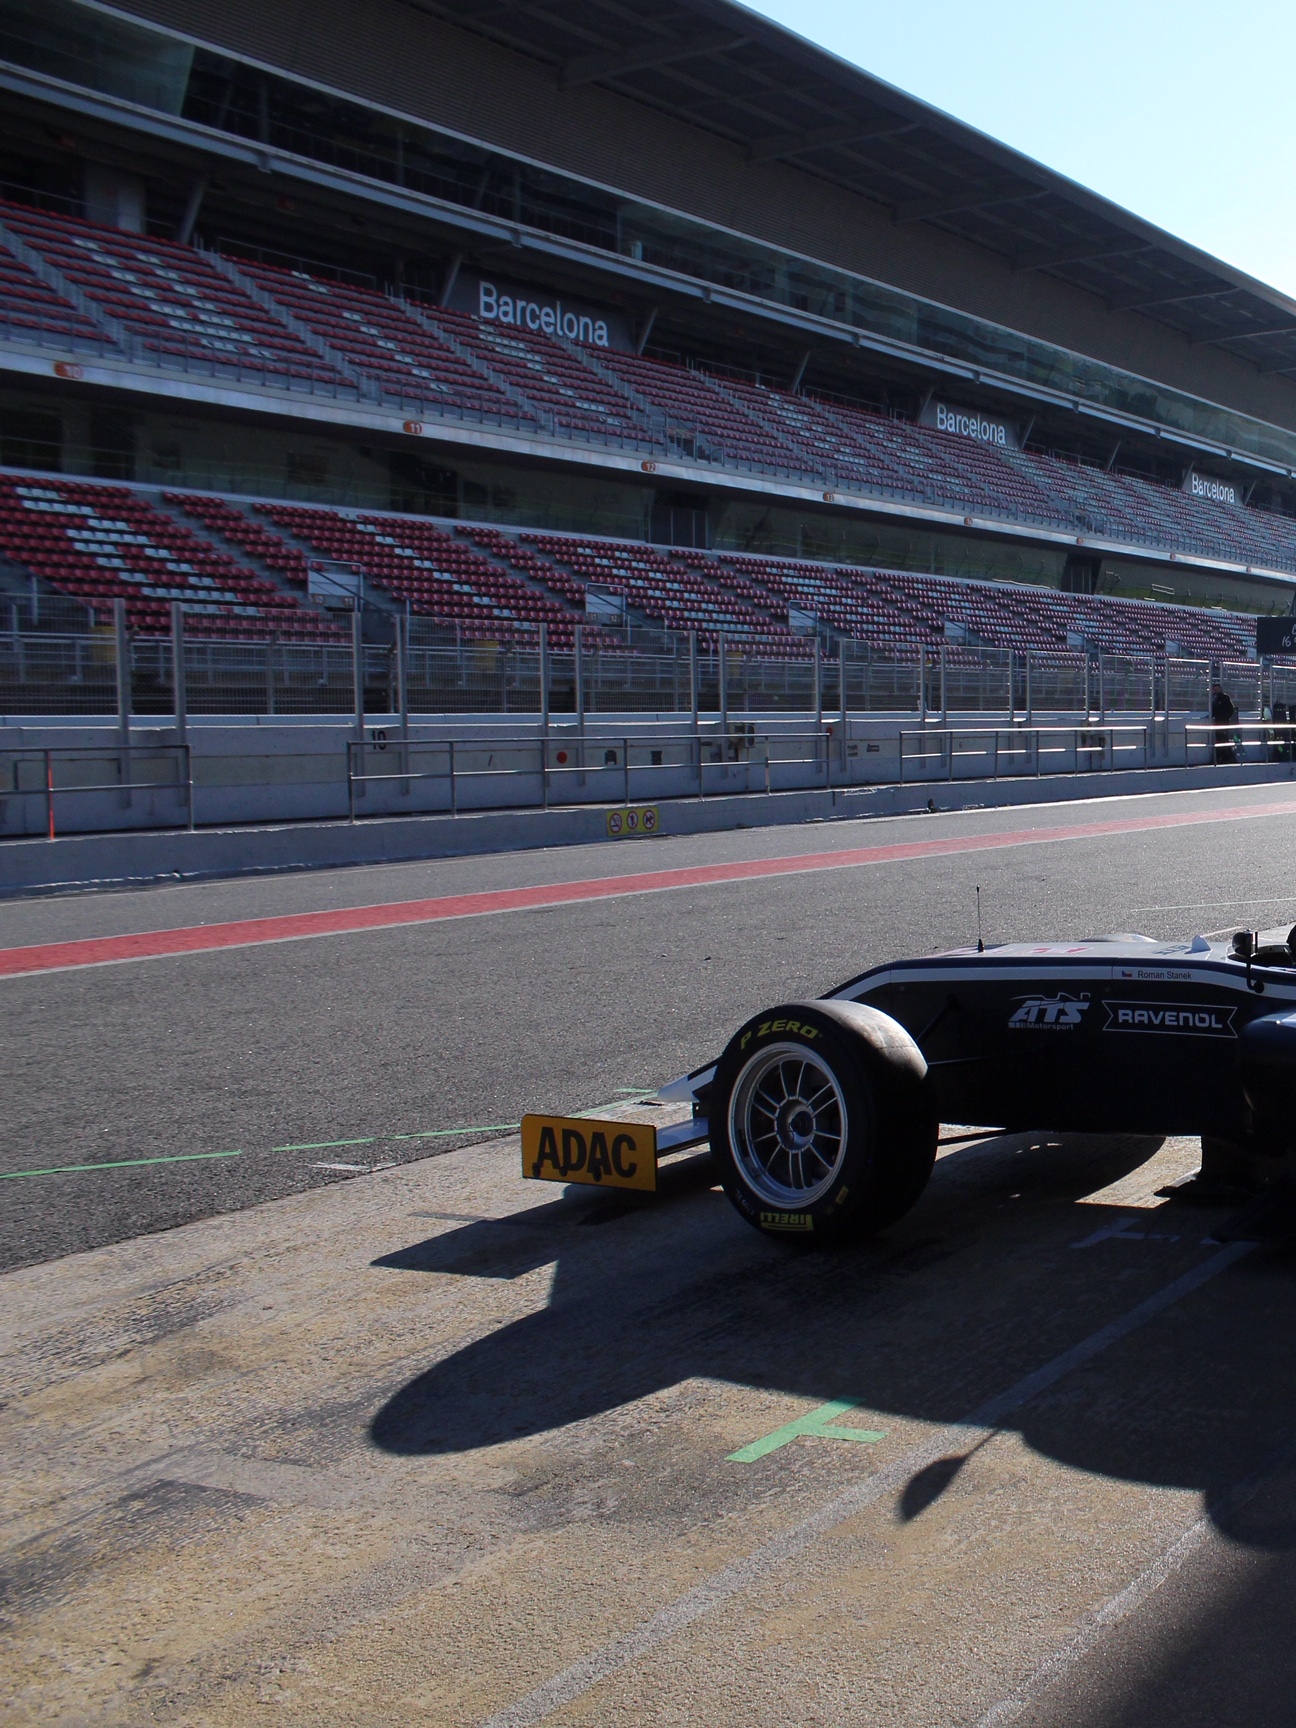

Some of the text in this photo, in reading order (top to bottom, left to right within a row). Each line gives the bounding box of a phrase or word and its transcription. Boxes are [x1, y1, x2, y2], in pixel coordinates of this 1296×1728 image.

[479, 280, 609, 346] Barcelona
[937, 403, 1006, 445] Barcelona
[1191, 473, 1236, 503] Barcelona
[1282, 636, 1291, 647] IS
[1137, 970, 1192, 980] Roman Stanek
[1009, 1000, 1091, 1024] ATS
[1118, 1008, 1223, 1029] RAVENOL
[740, 1019, 820, 1050] P ZERO
[1027, 1022, 1074, 1031] Motorsport
[536, 1126, 638, 1179] ADAC
[760, 1211, 814, 1231] PIRELLI
